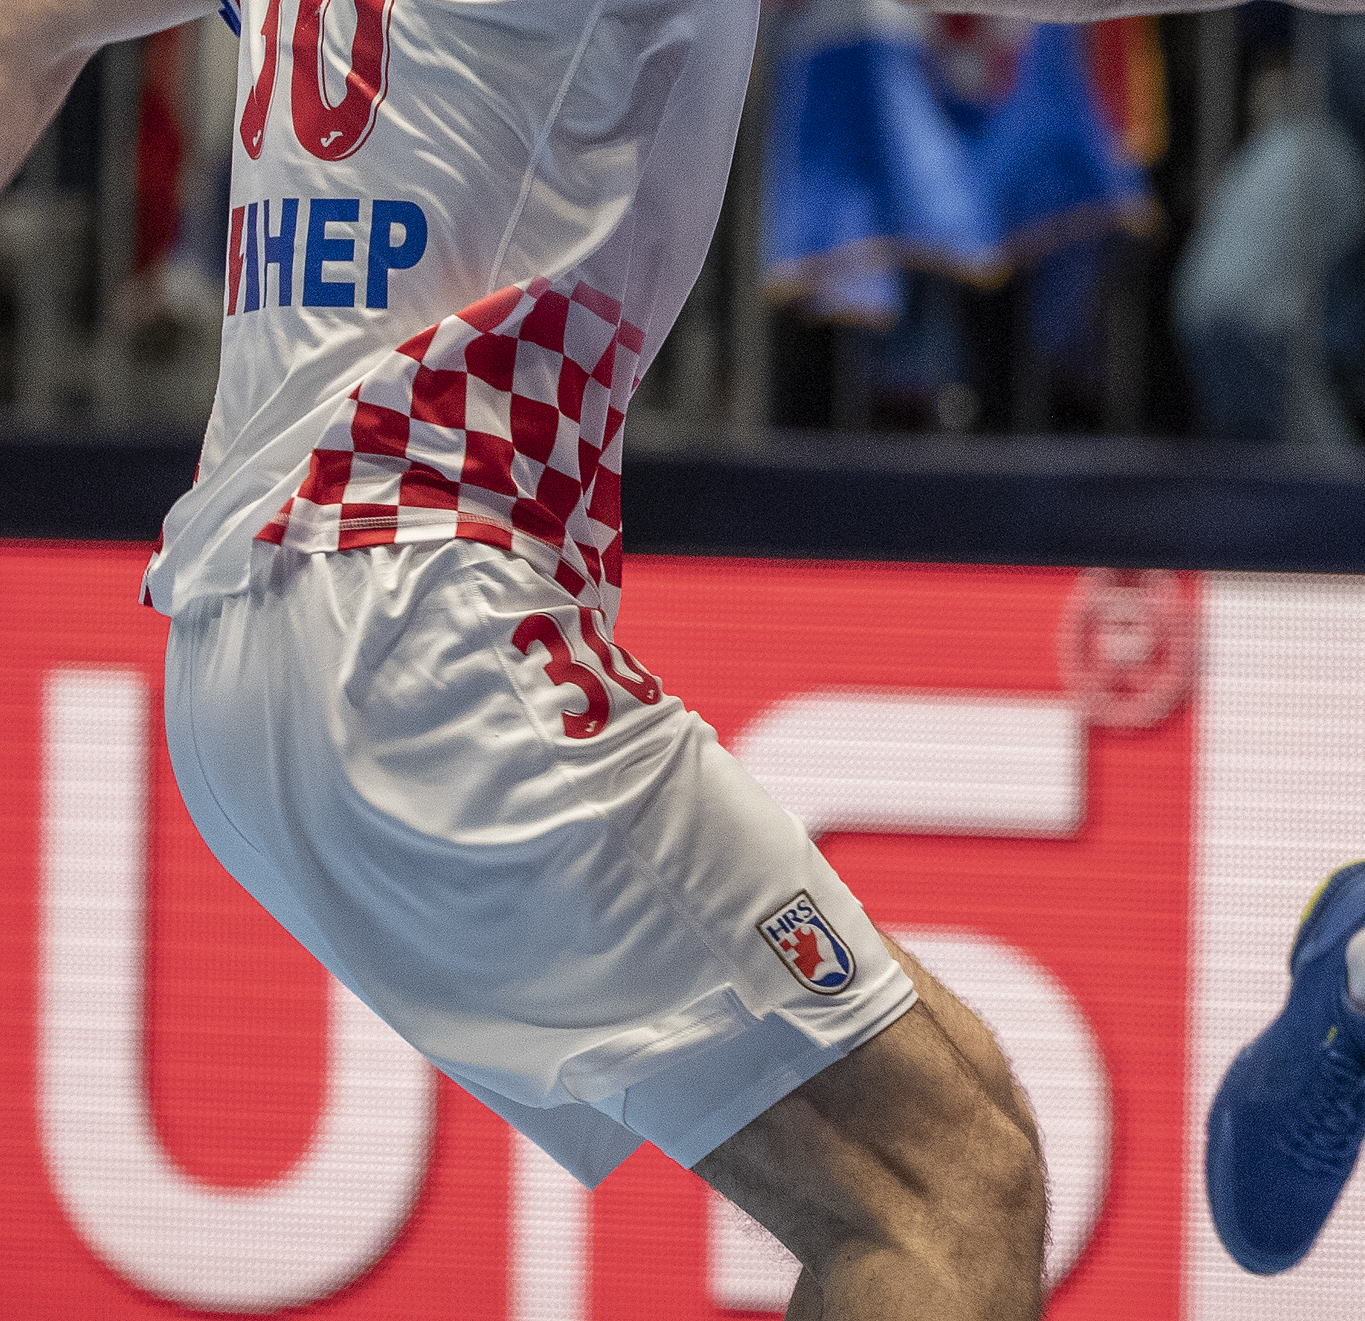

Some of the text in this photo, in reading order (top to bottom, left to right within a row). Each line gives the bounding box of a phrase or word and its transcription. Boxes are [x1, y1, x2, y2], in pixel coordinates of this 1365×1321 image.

[263, 197, 428, 309] HEP
[511, 605, 661, 739] 30
[766, 899, 813, 942] HRS
